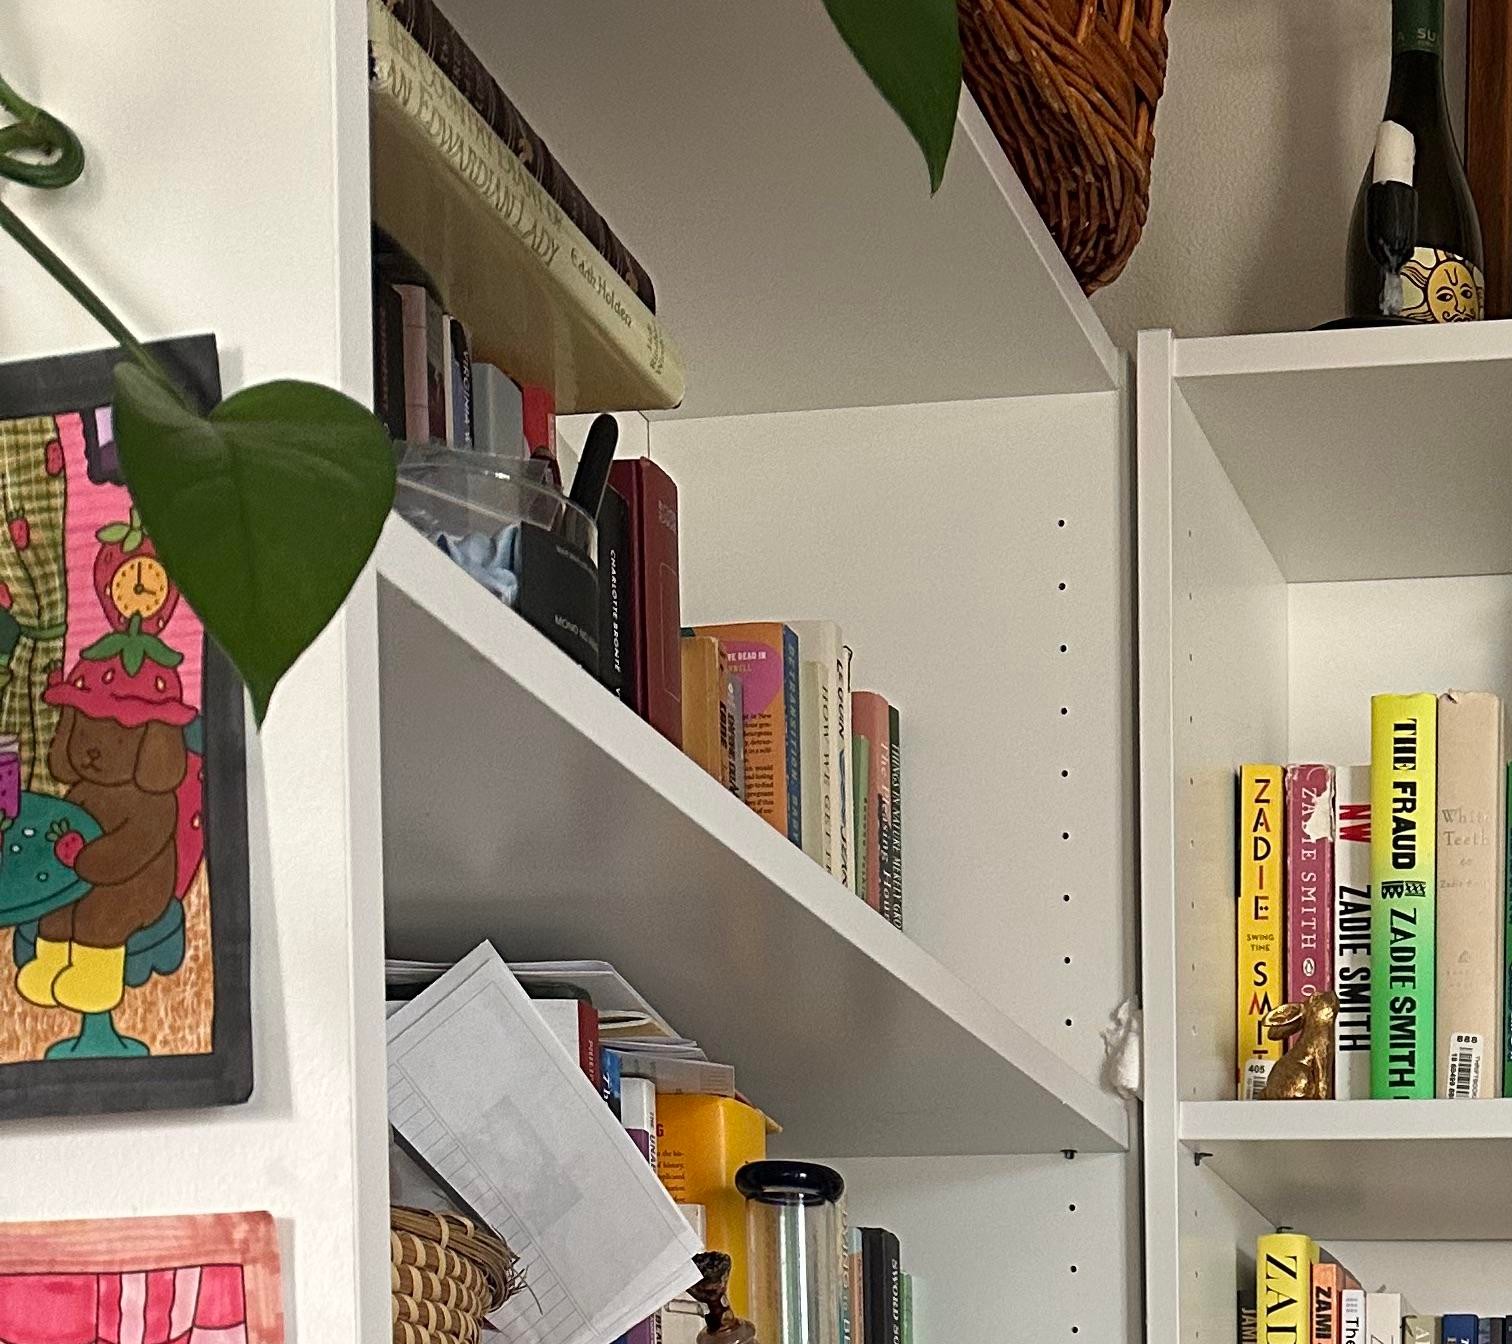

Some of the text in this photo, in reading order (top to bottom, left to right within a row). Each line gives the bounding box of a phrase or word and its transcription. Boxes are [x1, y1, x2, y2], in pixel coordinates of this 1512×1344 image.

[1339, 804, 1372, 1051] NW ZADIE SMITH
[1388, 719, 1418, 1088] THE FRAUD ZADIE SMITH
[1316, 1286, 1332, 1339] ZAMI
